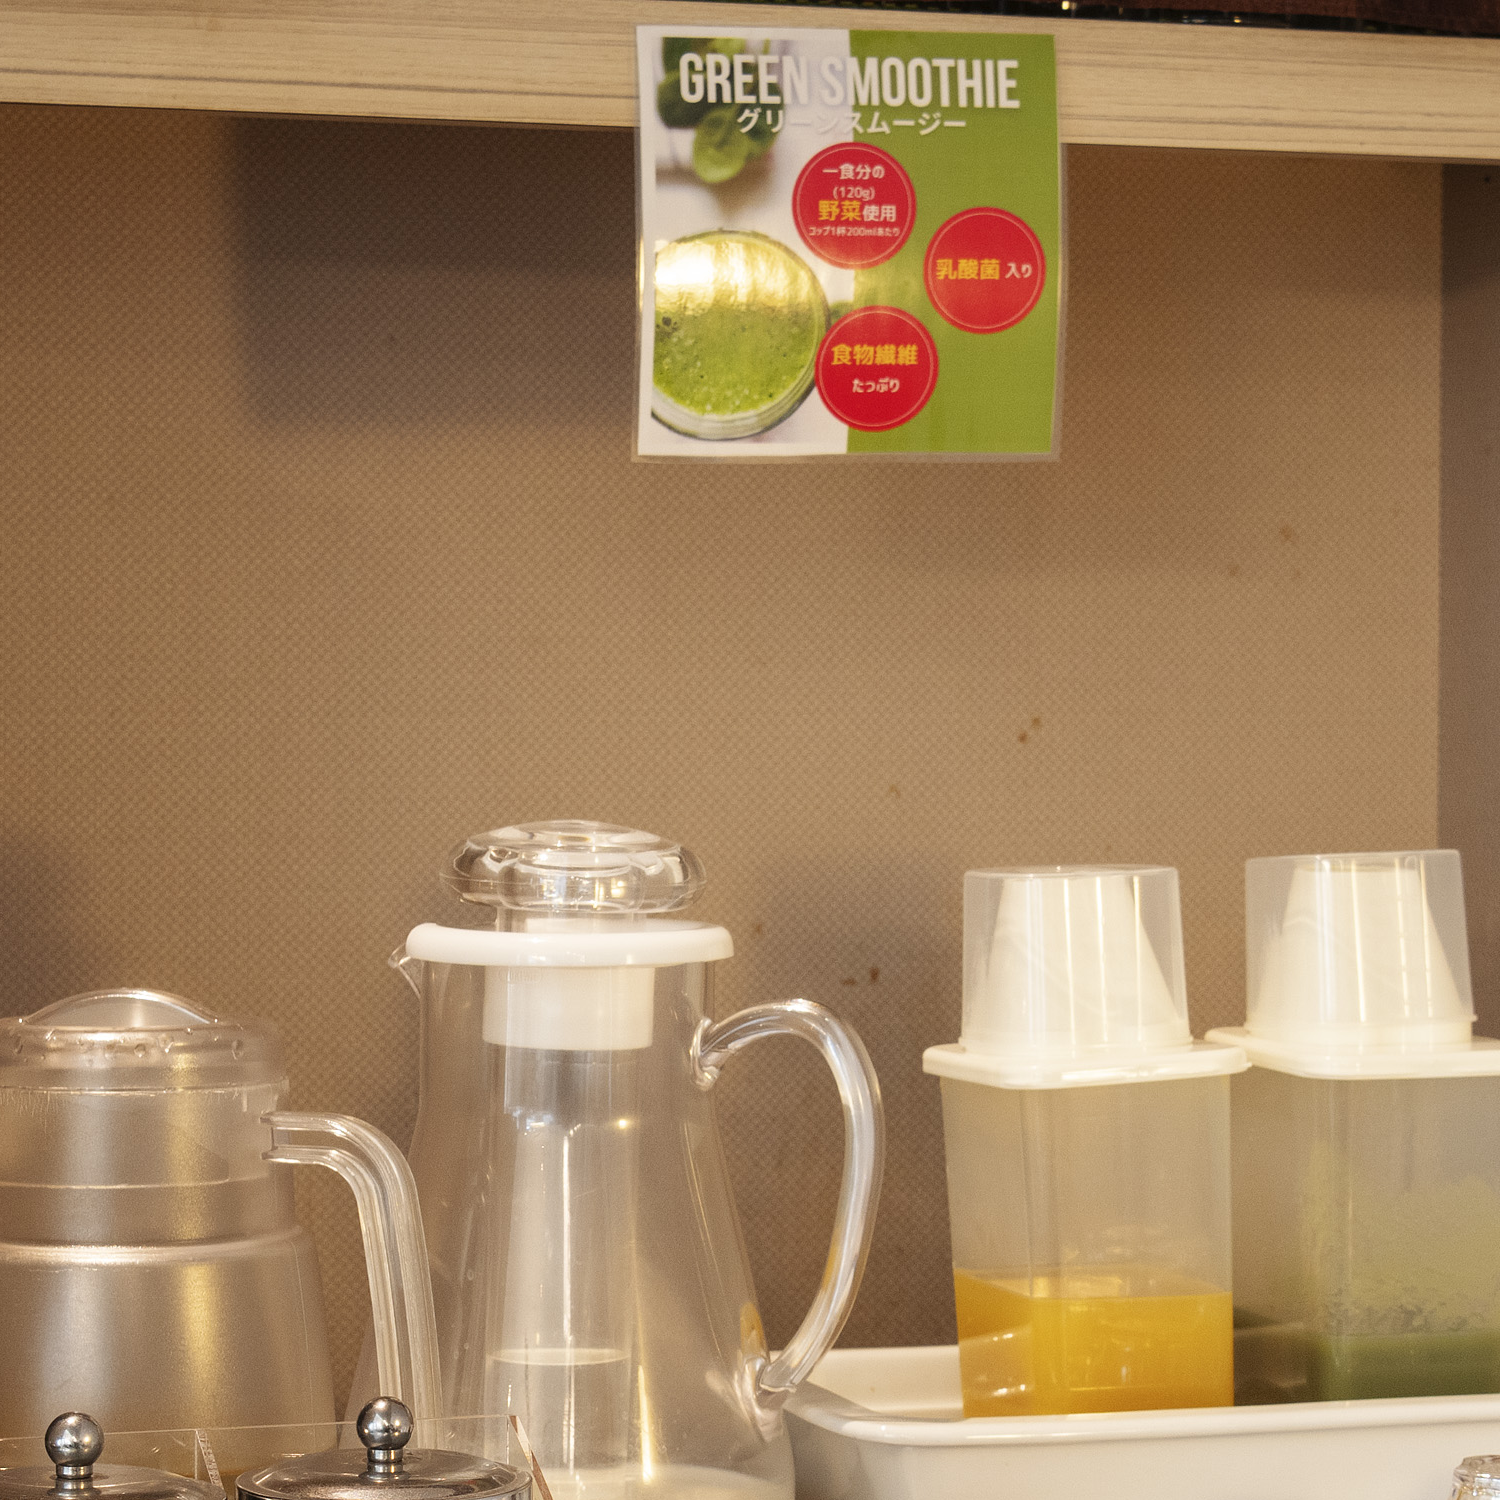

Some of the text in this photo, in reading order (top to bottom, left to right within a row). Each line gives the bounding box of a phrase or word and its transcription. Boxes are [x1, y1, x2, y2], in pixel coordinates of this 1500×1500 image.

[678, 52, 1021, 110] GREEN SMOOTHIE
[736, 107, 967, 136] グリーンスムージー
[822, 163, 885, 180] 一食分の
[832, 186, 876, 201] (120g)
[818, 200, 897, 222] 野菜使用
[831, 343, 919, 367] 食物繊維
[852, 377, 901, 394] たっぷり
